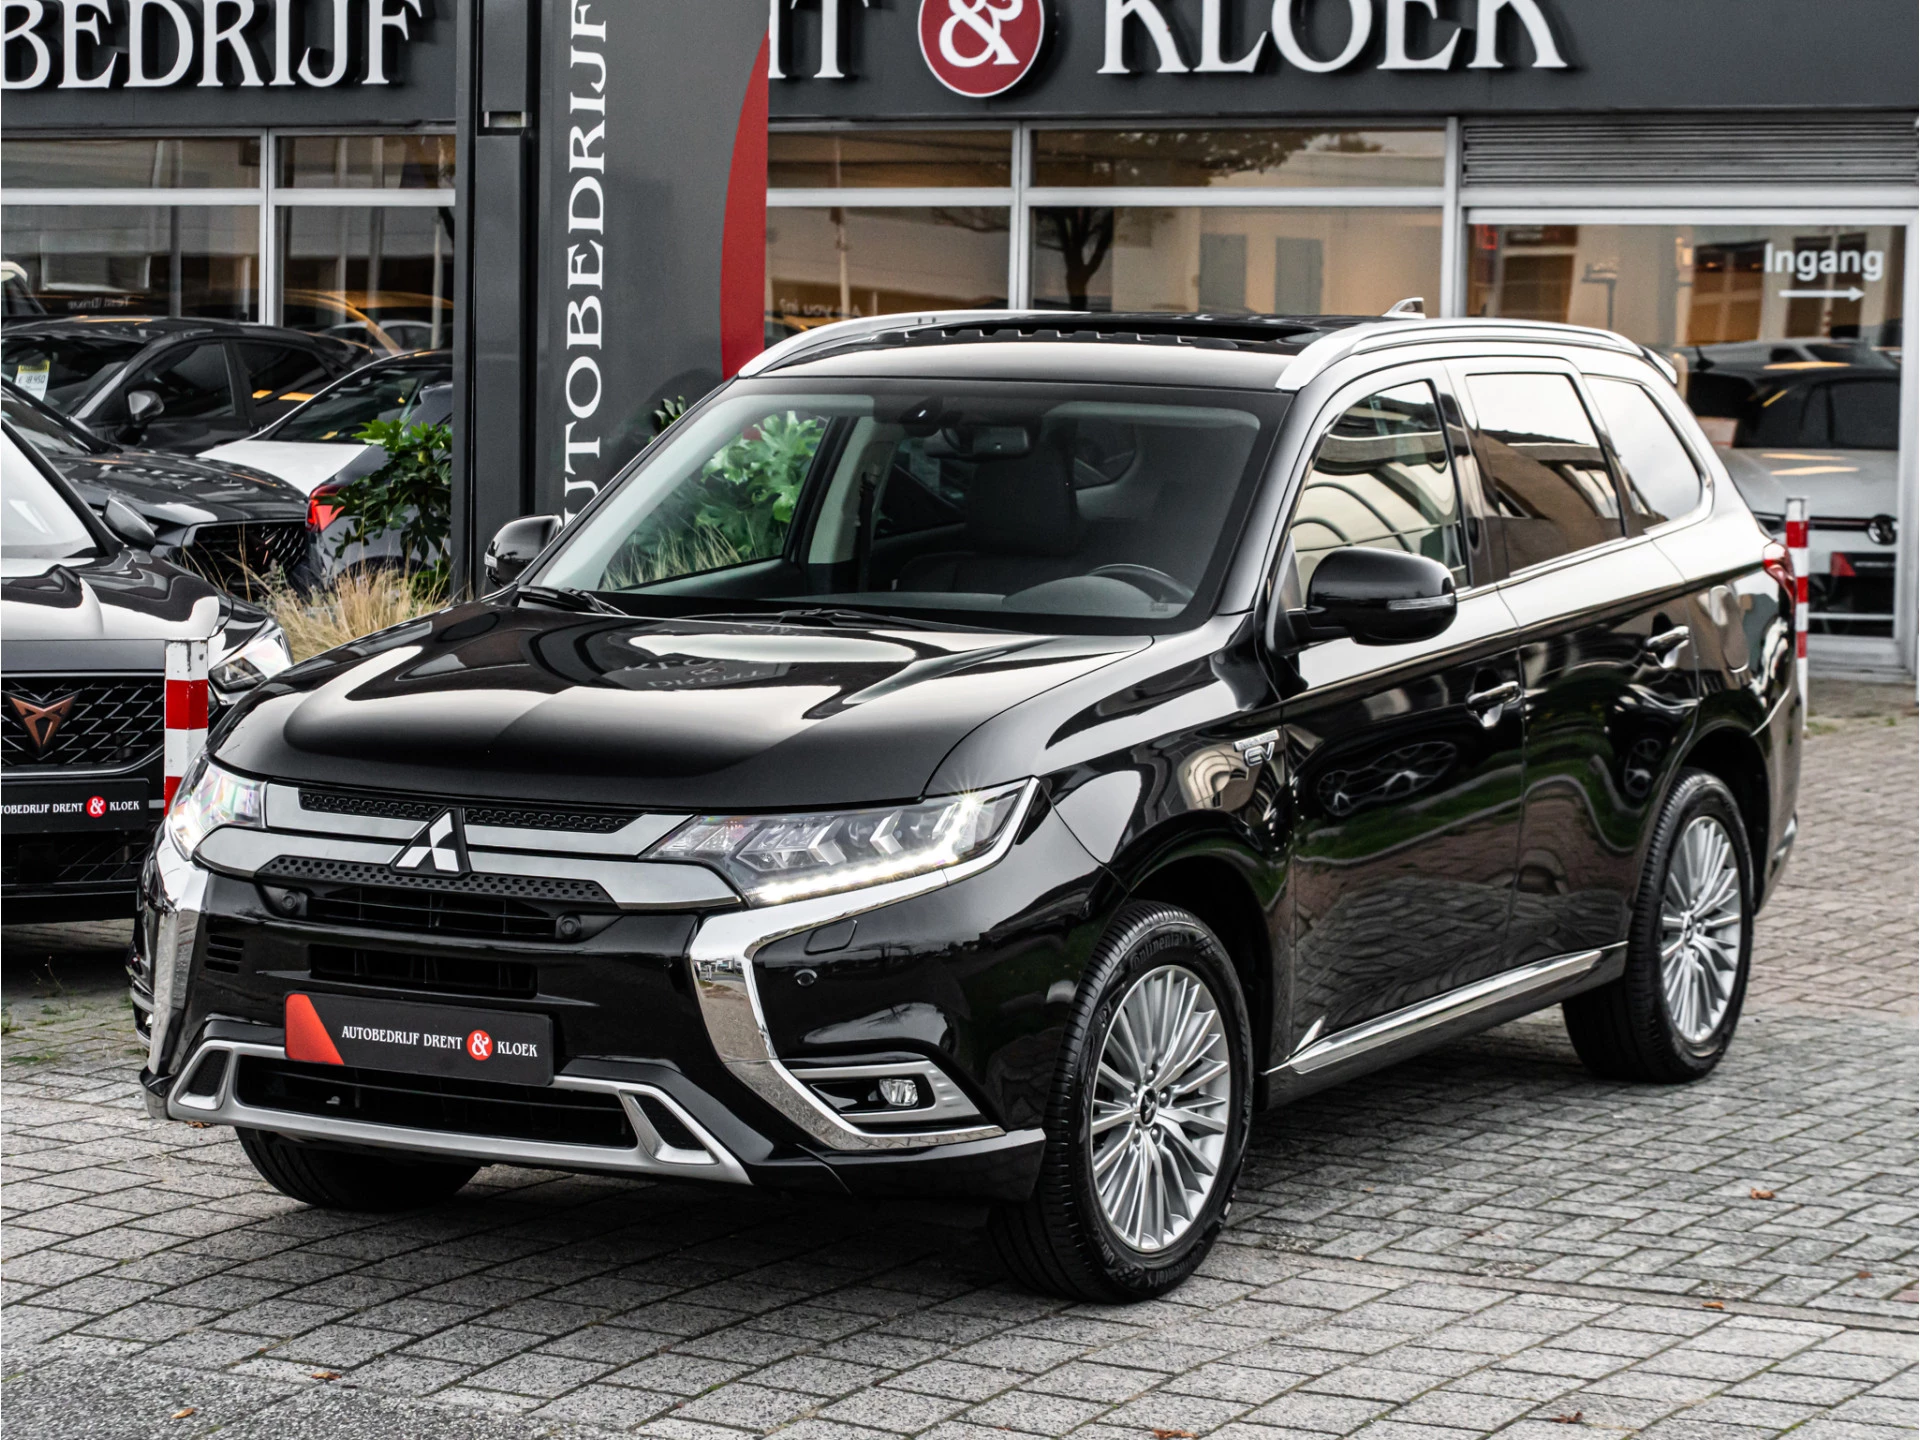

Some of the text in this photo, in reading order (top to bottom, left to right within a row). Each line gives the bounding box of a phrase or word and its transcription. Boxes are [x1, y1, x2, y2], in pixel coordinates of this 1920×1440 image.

[1, 0, 422, 89] BEDRIJF
[938, 0, 1024, 68] &
[1097, 0, 1568, 74] KLOEK
[1764, 242, 1884, 281] Ingang
[1244, 741, 1275, 767] EV
[52, 802, 83, 813] DRENT
[90, 797, 104, 815] &
[109, 800, 140, 811] KLOEK
[341, 1025, 538, 1057] AUTOBEDRIJF DRENT & KLOEK
